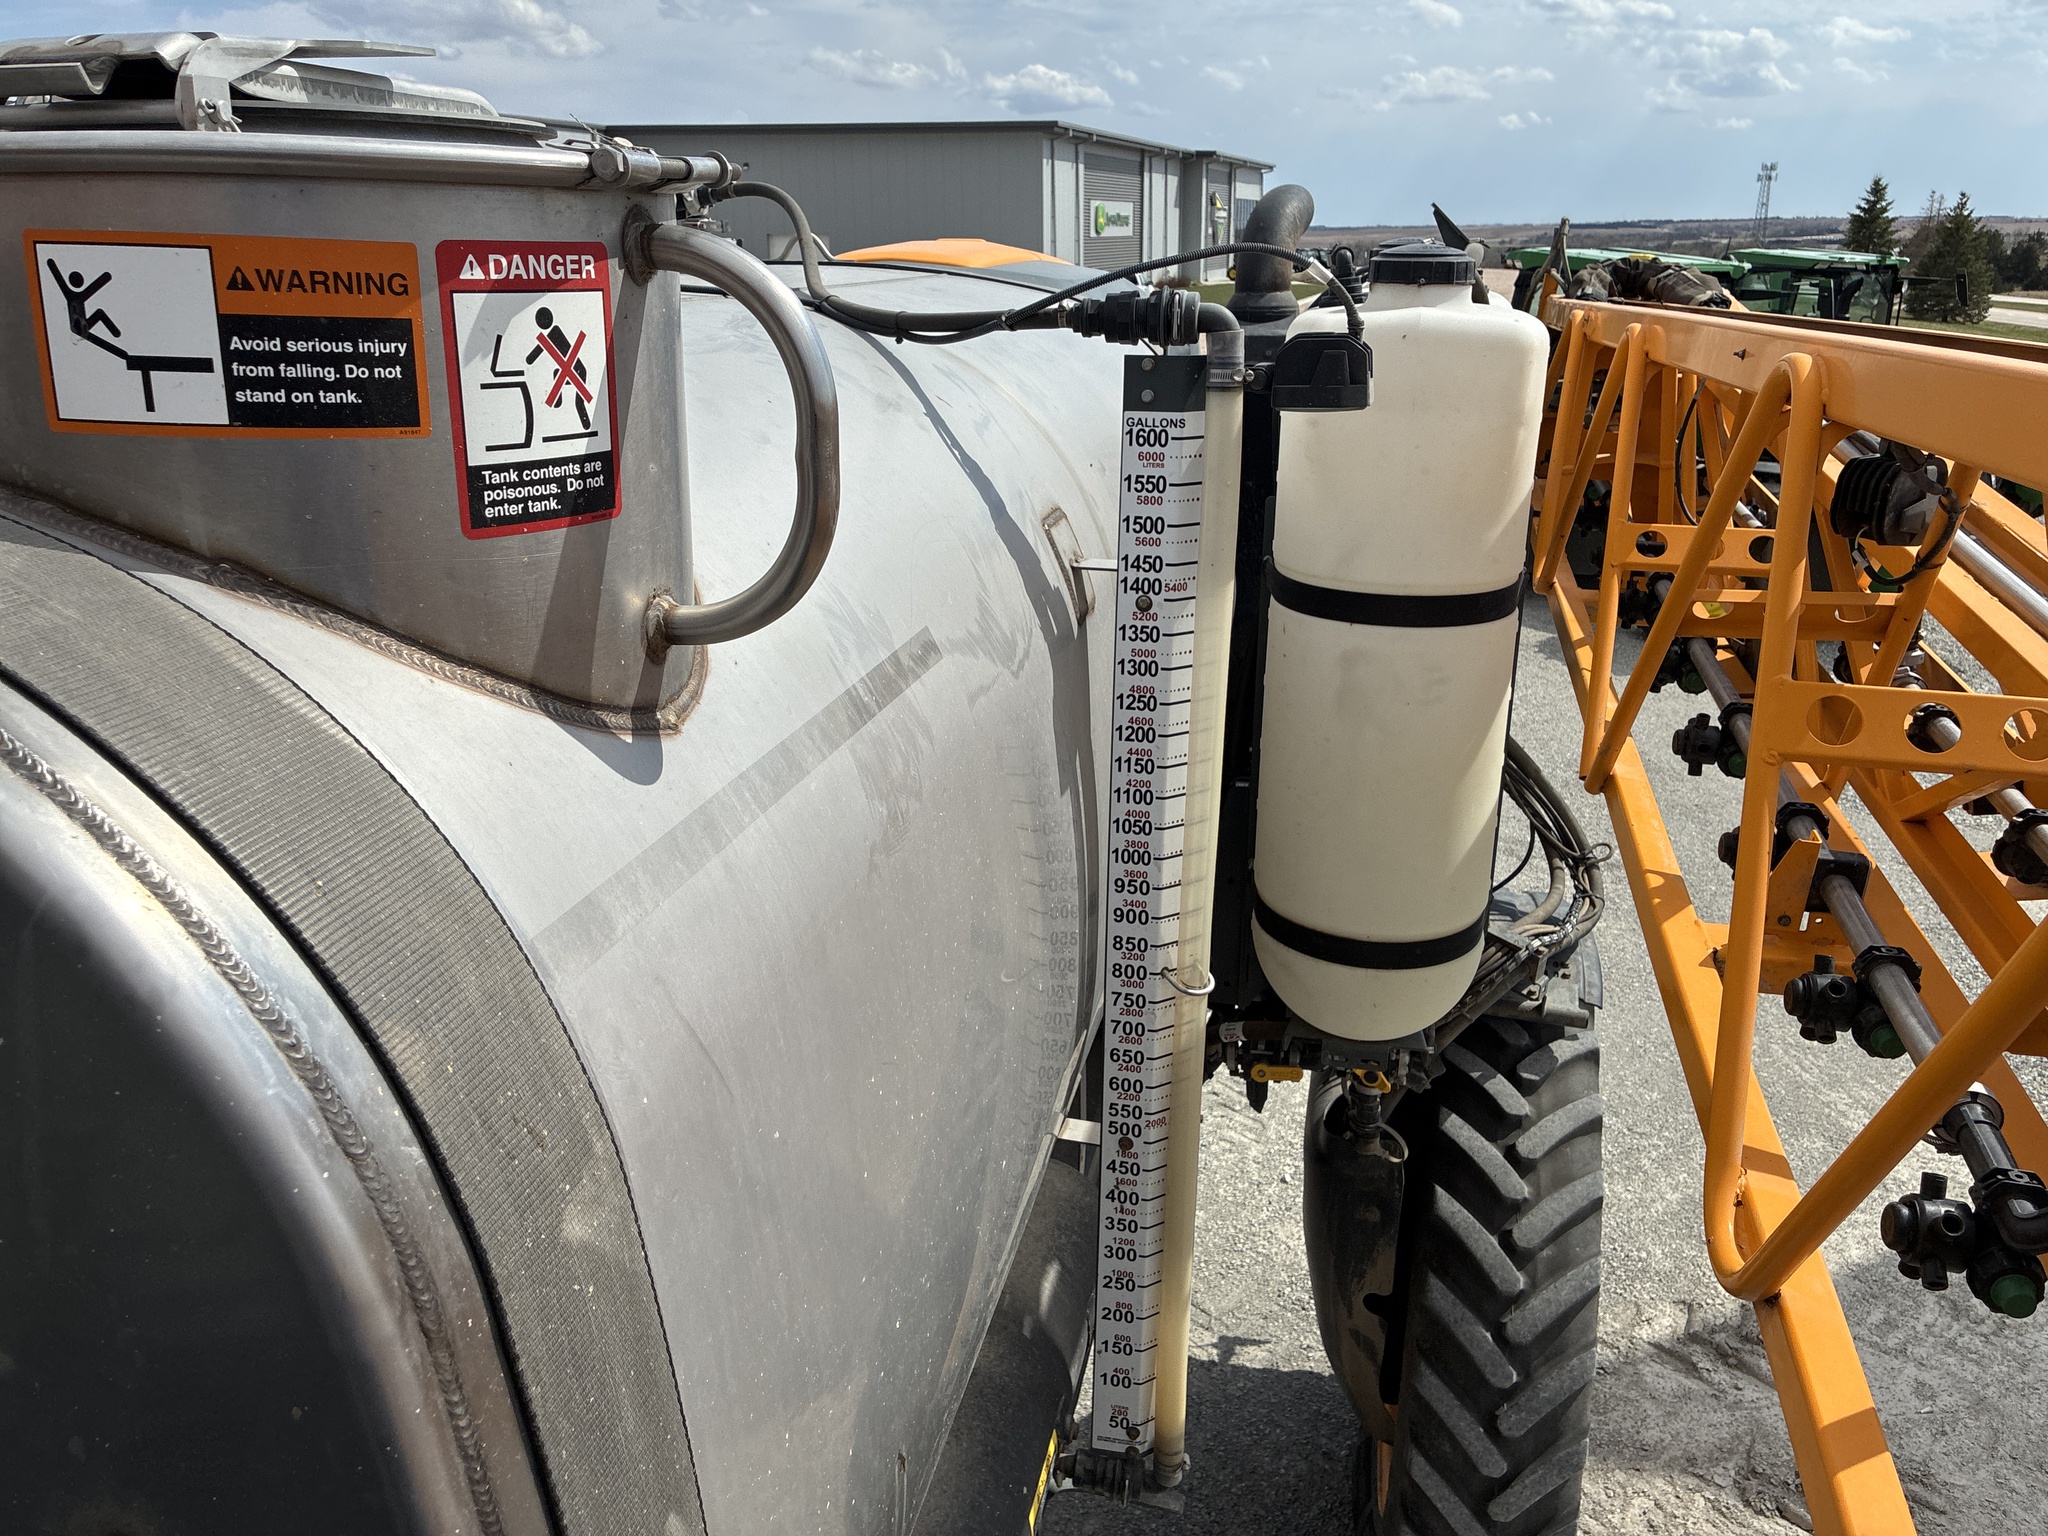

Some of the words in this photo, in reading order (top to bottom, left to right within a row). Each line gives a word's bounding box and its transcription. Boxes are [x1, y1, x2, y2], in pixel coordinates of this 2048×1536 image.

[488, 253, 596, 281] DANGER
[254, 267, 410, 297] WARNING
[229, 335, 282, 354] Avoid
[286, 337, 354, 354] serious
[358, 338, 408, 359] injury
[231, 360, 275, 378] from
[278, 360, 341, 383] falling.
[345, 363, 368, 379] Do
[372, 364, 402, 380] not
[234, 387, 287, 403] stand
[290, 389, 314, 403] on
[317, 387, 363, 404] tank.
[1126, 417, 1187, 429] GALLONS
[1125, 428, 1169, 448] 1600
[1137, 451, 1165, 462] 6000
[481, 469, 519, 484] Tank
[522, 463, 580, 482] contents
[583, 460, 602, 474] are
[483, 482, 561, 504] poisonous.
[566, 477, 584, 491] Do
[586, 474, 605, 490] not
[1123, 474, 1167, 494] 1550
[485, 501, 524, 517] enter
[527, 496, 562, 513] tank.
[1135, 495, 1163, 506] 5800
[1121, 515, 1165, 535] 1500
[1134, 536, 1162, 547] 5600
[1120, 555, 1164, 573] 1450
[1119, 577, 1163, 596] 1400
[1164, 581, 1188, 592] 5400
[1131, 611, 1159, 622] 5200
[1118, 624, 1160, 643] 1350
[1130, 648, 1157, 659] 5000
[1117, 659, 1159, 677] 1300
[1128, 684, 1155, 695] 4800
[1115, 693, 1158, 712] 1250
[1127, 716, 1154, 727] 4600
[1114, 725, 1156, 744] 1200
[1126, 748, 1153, 758] 4400
[1114, 756, 1155, 775] 1150
[1125, 779, 1152, 789] 4200
[1113, 787, 1154, 806] 1100
[1124, 810, 1151, 820] 4000
[1112, 817, 1153, 836] 1050
[1123, 840, 1150, 850] 3800
[1111, 848, 1152, 866] 1000
[1123, 870, 1148, 880] 3600
[1113, 878, 1151, 896] 950
[1122, 899, 1147, 909] 3400
[1112, 908, 1150, 926] 900
[1112, 935, 1149, 953] 850
[1120, 951, 1146, 962] 3200
[1111, 963, 1148, 981] 800
[1119, 979, 1145, 989] 3000
[1110, 991, 1147, 1009] 750
[1118, 1008, 1144, 1018] 2800
[1110, 1020, 1146, 1038] 700
[1118, 1036, 1143, 1046] 2600
[1109, 1048, 1145, 1066] 650
[1117, 1063, 1142, 1074] 2400
[1108, 1076, 1144, 1094] 600
[1116, 1092, 1141, 1102] 2200
[1108, 1103, 1143, 1121] 550
[1107, 1120, 1143, 1138] 500
[1114, 1149, 1139, 1160] 1800
[1105, 1159, 1141, 1177] 450
[1105, 1188, 1140, 1206] 400
[1104, 1216, 1139, 1234] 350
[1112, 1237, 1135, 1247] 1200
[1103, 1245, 1138, 1262] 300
[1111, 1269, 1134, 1280] 1000
[1102, 1275, 1136, 1293] 250
[1115, 1301, 1133, 1311] 800
[1101, 1307, 1135, 1324] 200
[1114, 1334, 1132, 1344] 600
[1100, 1340, 1133, 1357] 150
[1112, 1366, 1130, 1376] 400
[1099, 1372, 1132, 1389] 100
[1109, 1416, 1130, 1430] 50
